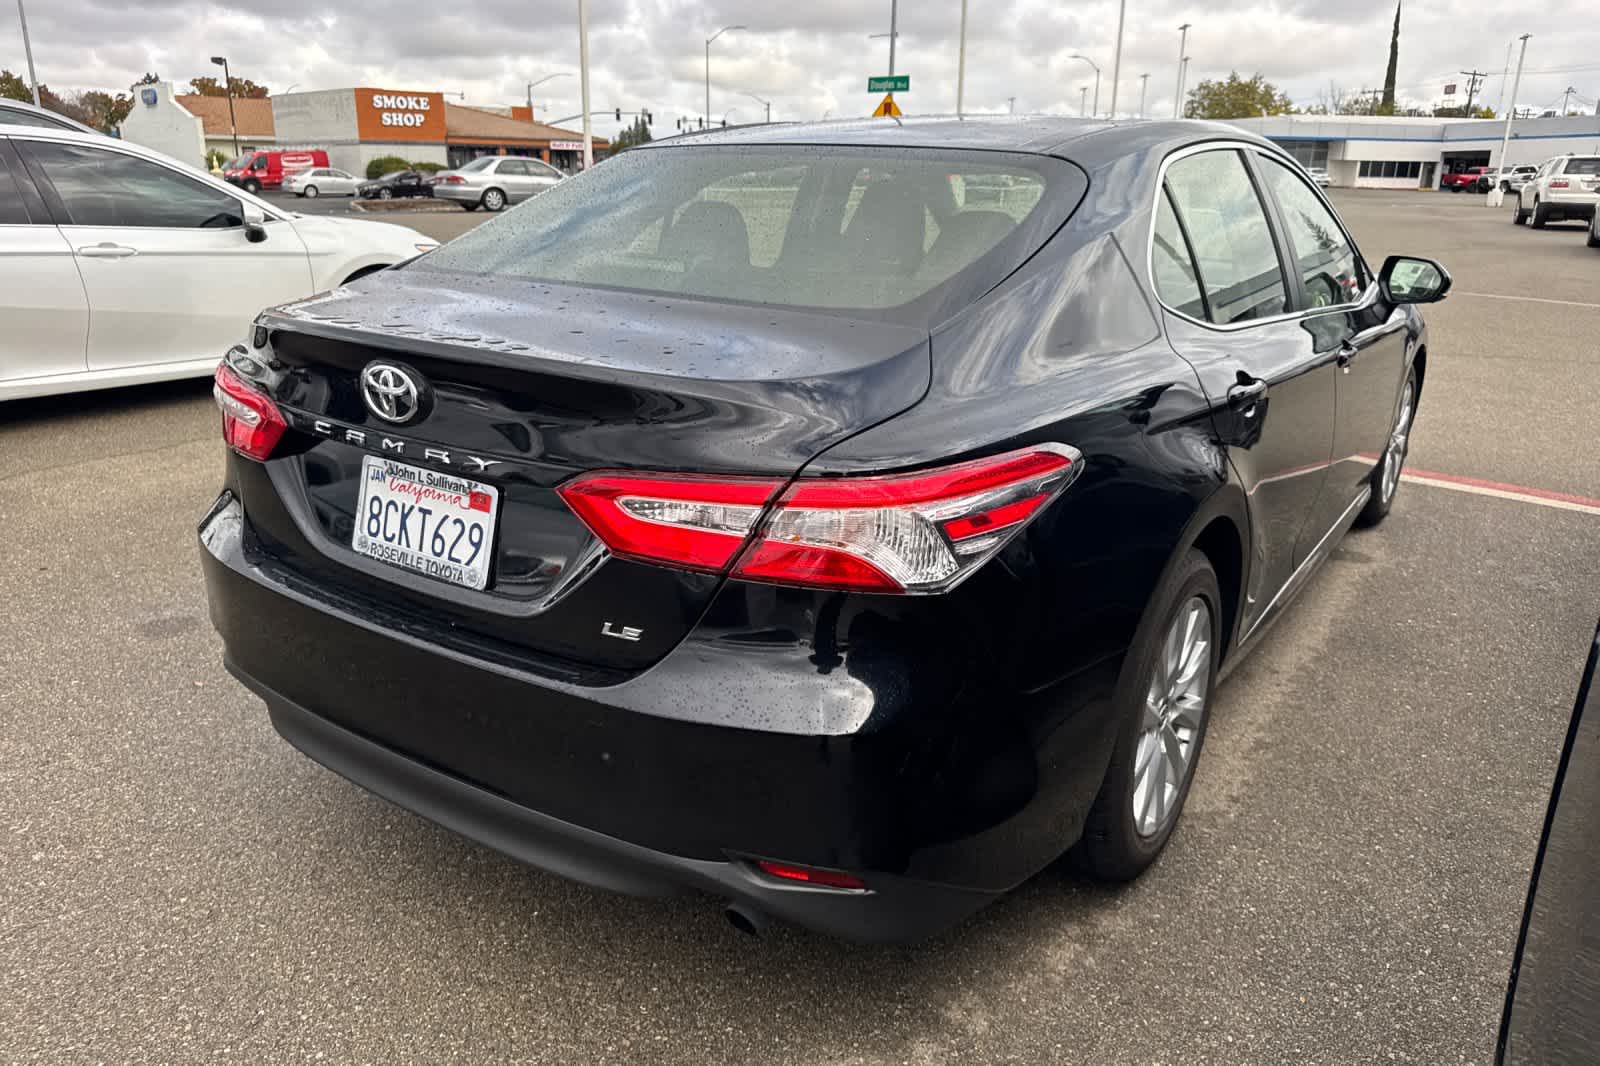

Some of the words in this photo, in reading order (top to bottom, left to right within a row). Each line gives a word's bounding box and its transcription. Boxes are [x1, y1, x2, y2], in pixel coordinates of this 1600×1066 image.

[372, 94, 430, 110] SMOKE
[381, 112, 425, 127] SHOP
[314, 419, 502, 471] CAMRY
[371, 468, 386, 483] JAN
[392, 463, 415, 480] John
[418, 470, 424, 483] L
[426, 472, 465, 493] Sullivan
[389, 477, 469, 509] California
[367, 495, 484, 566] 8CKT629
[370, 542, 423, 569] ROSEVILLE
[425, 559, 464, 582] TOYOTA
[601, 621, 644, 641] LE
